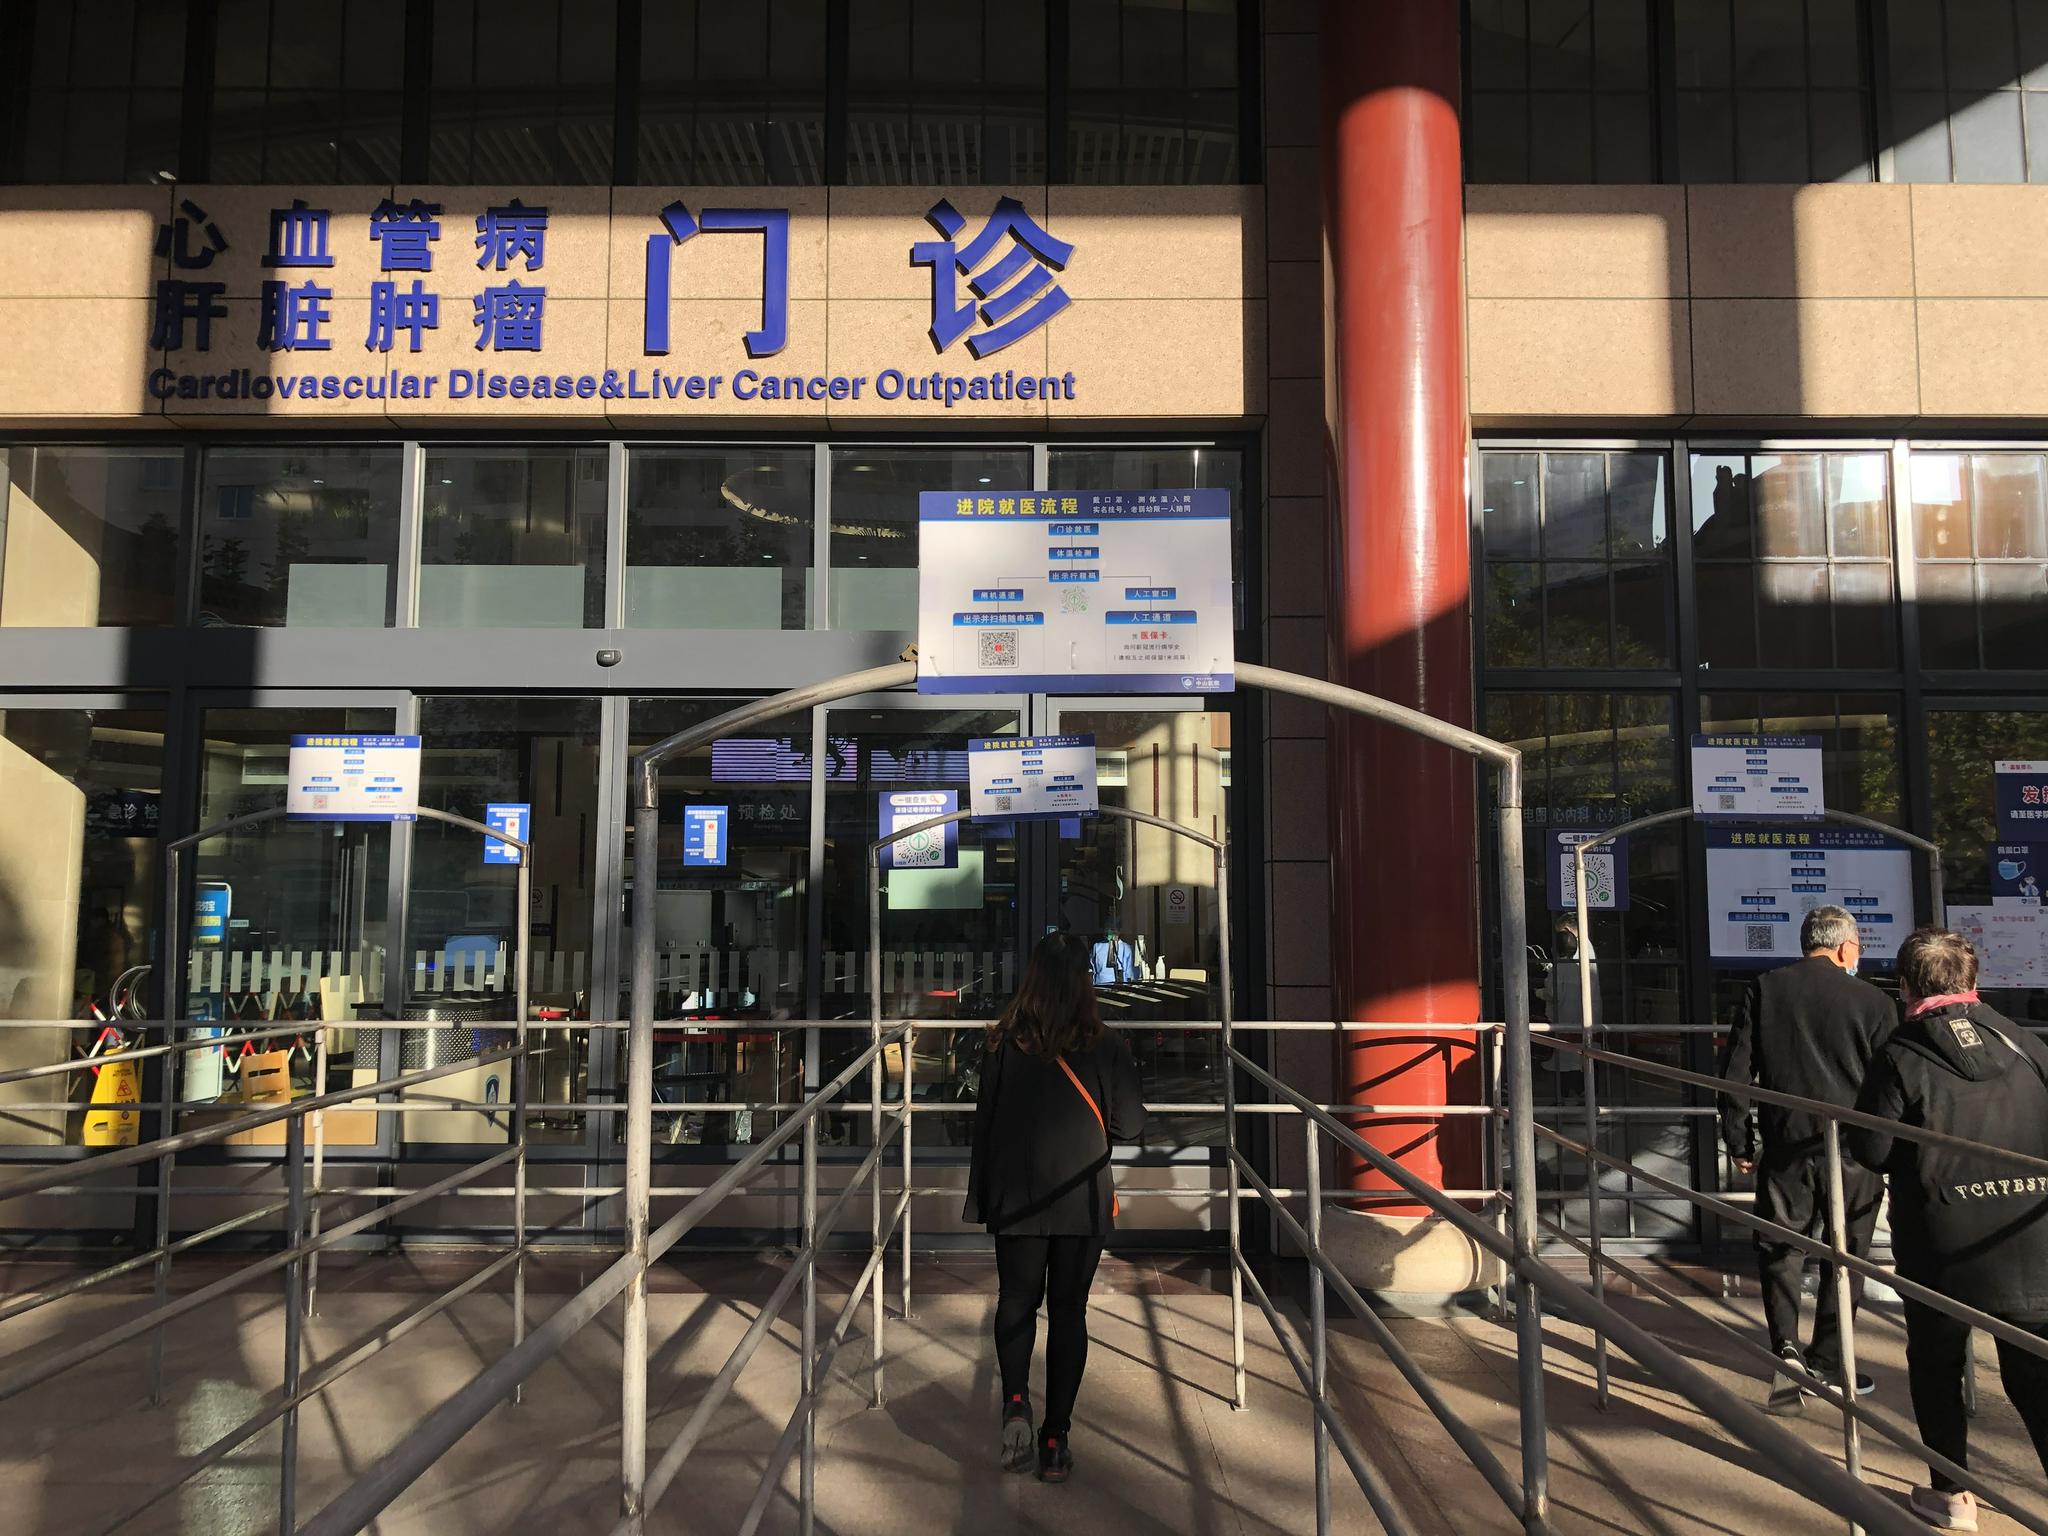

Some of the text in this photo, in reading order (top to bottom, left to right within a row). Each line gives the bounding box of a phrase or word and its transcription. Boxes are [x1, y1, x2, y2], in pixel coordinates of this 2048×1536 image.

[155, 198, 548, 271] 心血管病
[644, 196, 1076, 360] 门诊
[150, 279, 548, 352] 肝脏肿瘤
[149, 368, 1077, 407] Cardiovascular Disease&Liver Cancer Outpatient
[956, 497, 1079, 515] 进院就医流程
[1056, 525, 1092, 534] 门诊就医
[1134, 590, 1169, 598] 人工窗口
[1131, 613, 1171, 622] 人工通道
[738, 804, 801, 820] 预检处
[1552, 807, 1590, 823] 心内科
[1731, 833, 1810, 845] 进院就医流程
